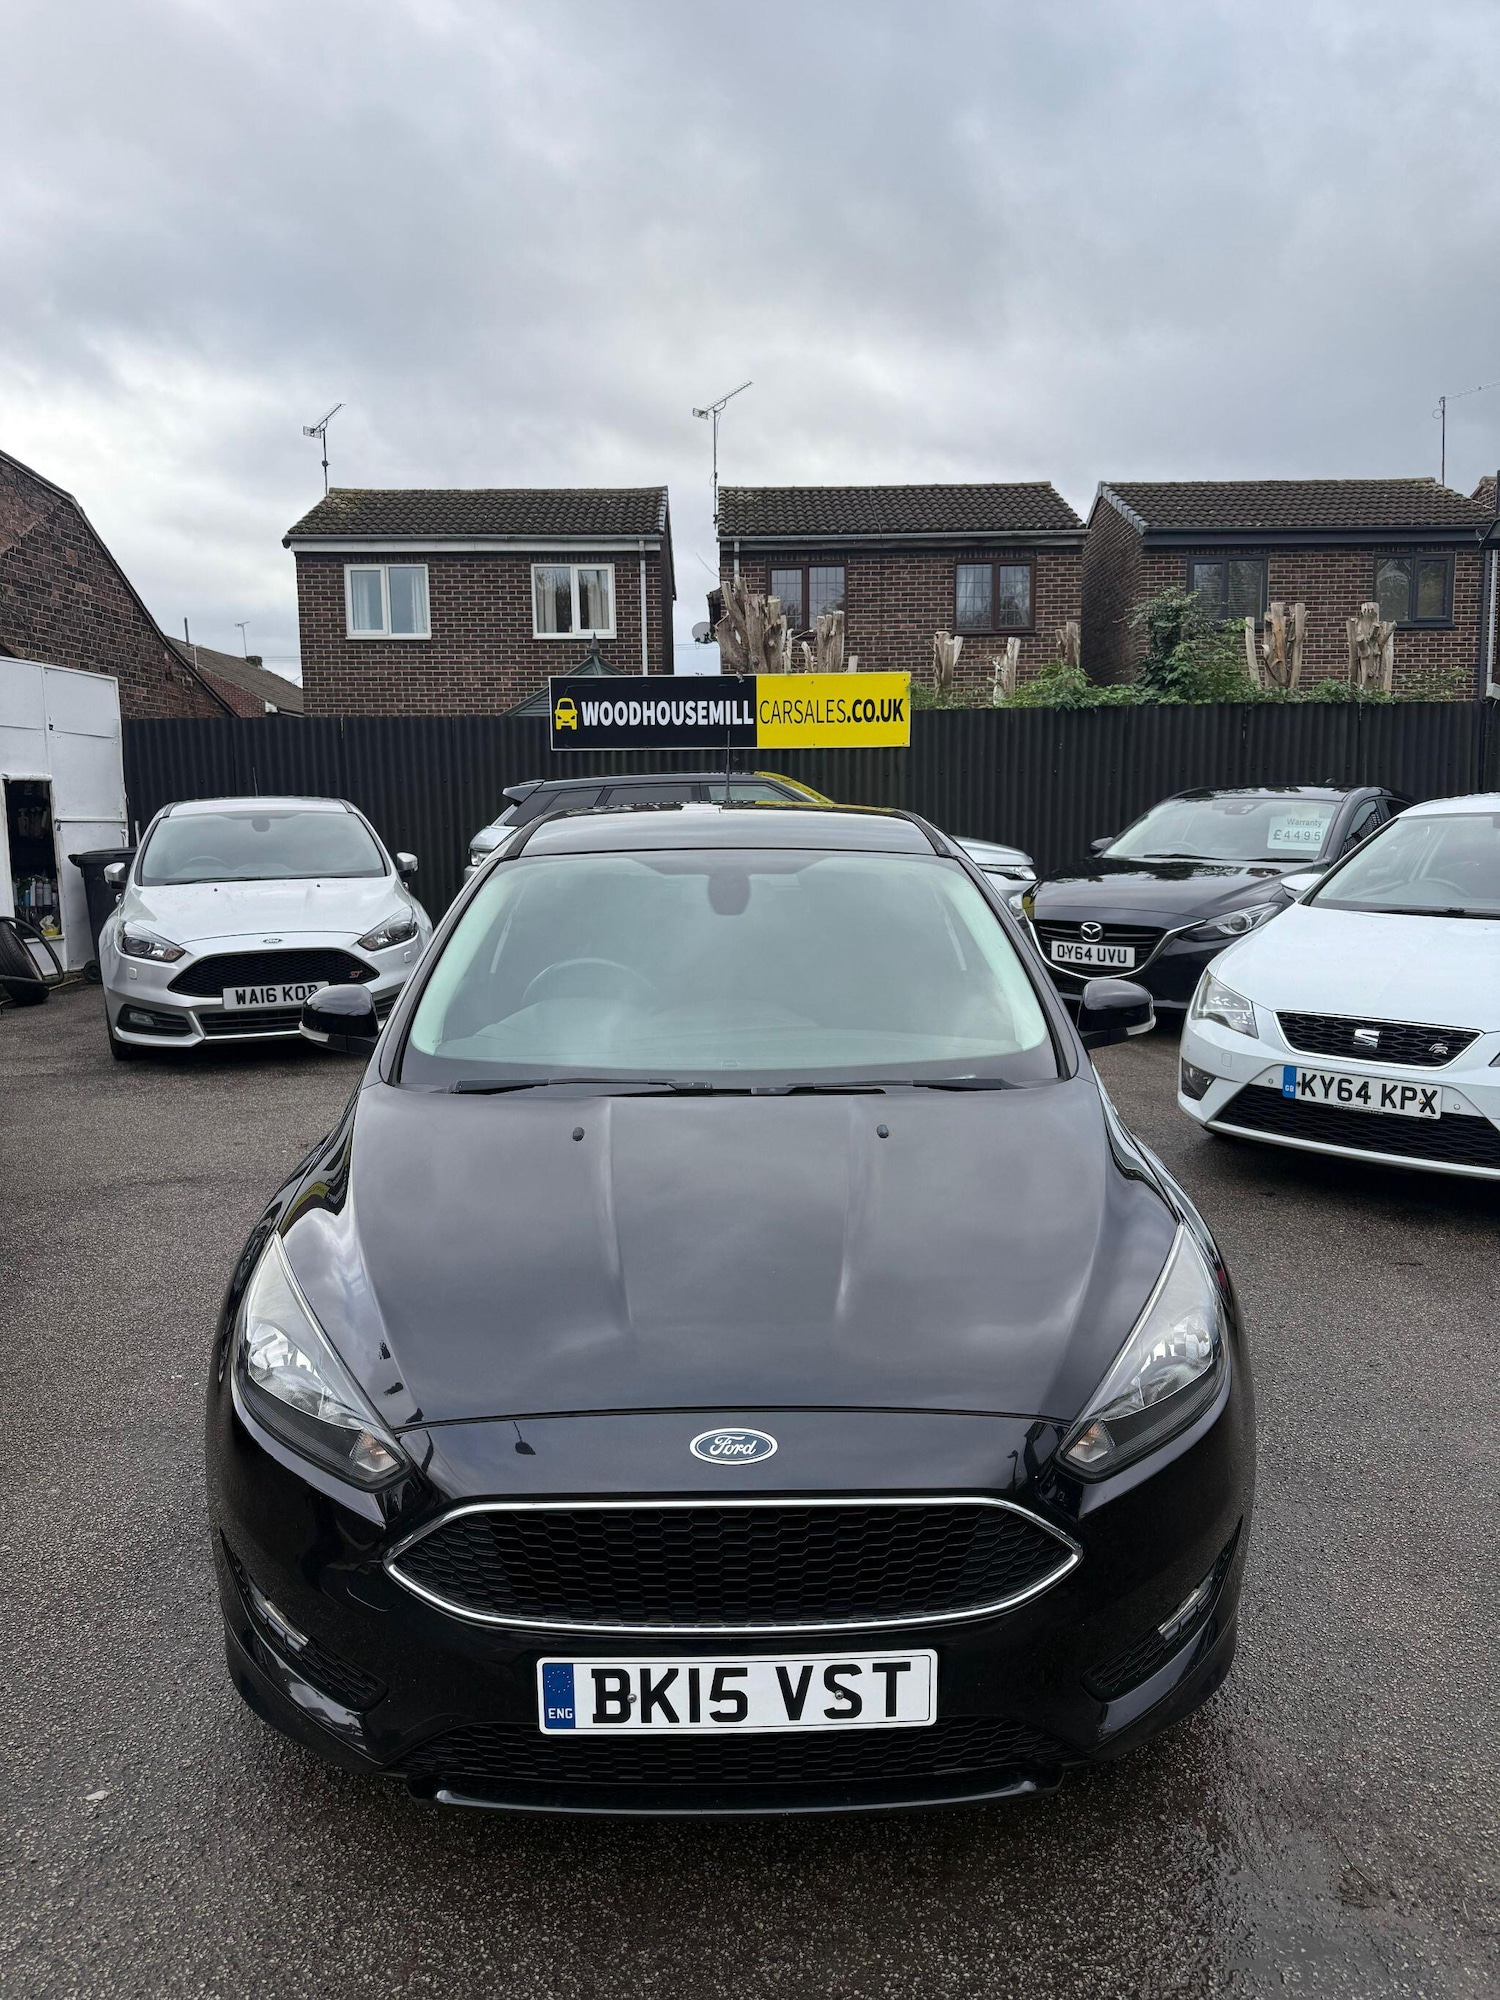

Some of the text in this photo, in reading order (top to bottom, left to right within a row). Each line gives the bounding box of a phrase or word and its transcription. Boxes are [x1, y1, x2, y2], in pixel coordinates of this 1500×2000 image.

[581, 698, 905, 727] WOODHOUSEMILL CARSALES.CO.UK
[1287, 818, 1322, 827] Warranty
[1273, 829, 1321, 841] £4495
[1057, 944, 1127, 964] OY64 UVU
[235, 987, 277, 1005] WA16
[1285, 1084, 1295, 1093] GB
[1300, 1072, 1438, 1115] KY64 KPX
[709, 1435, 757, 1455] Ford
[591, 1661, 911, 1723] BK15 VST
[548, 1707, 573, 1720] ENG
